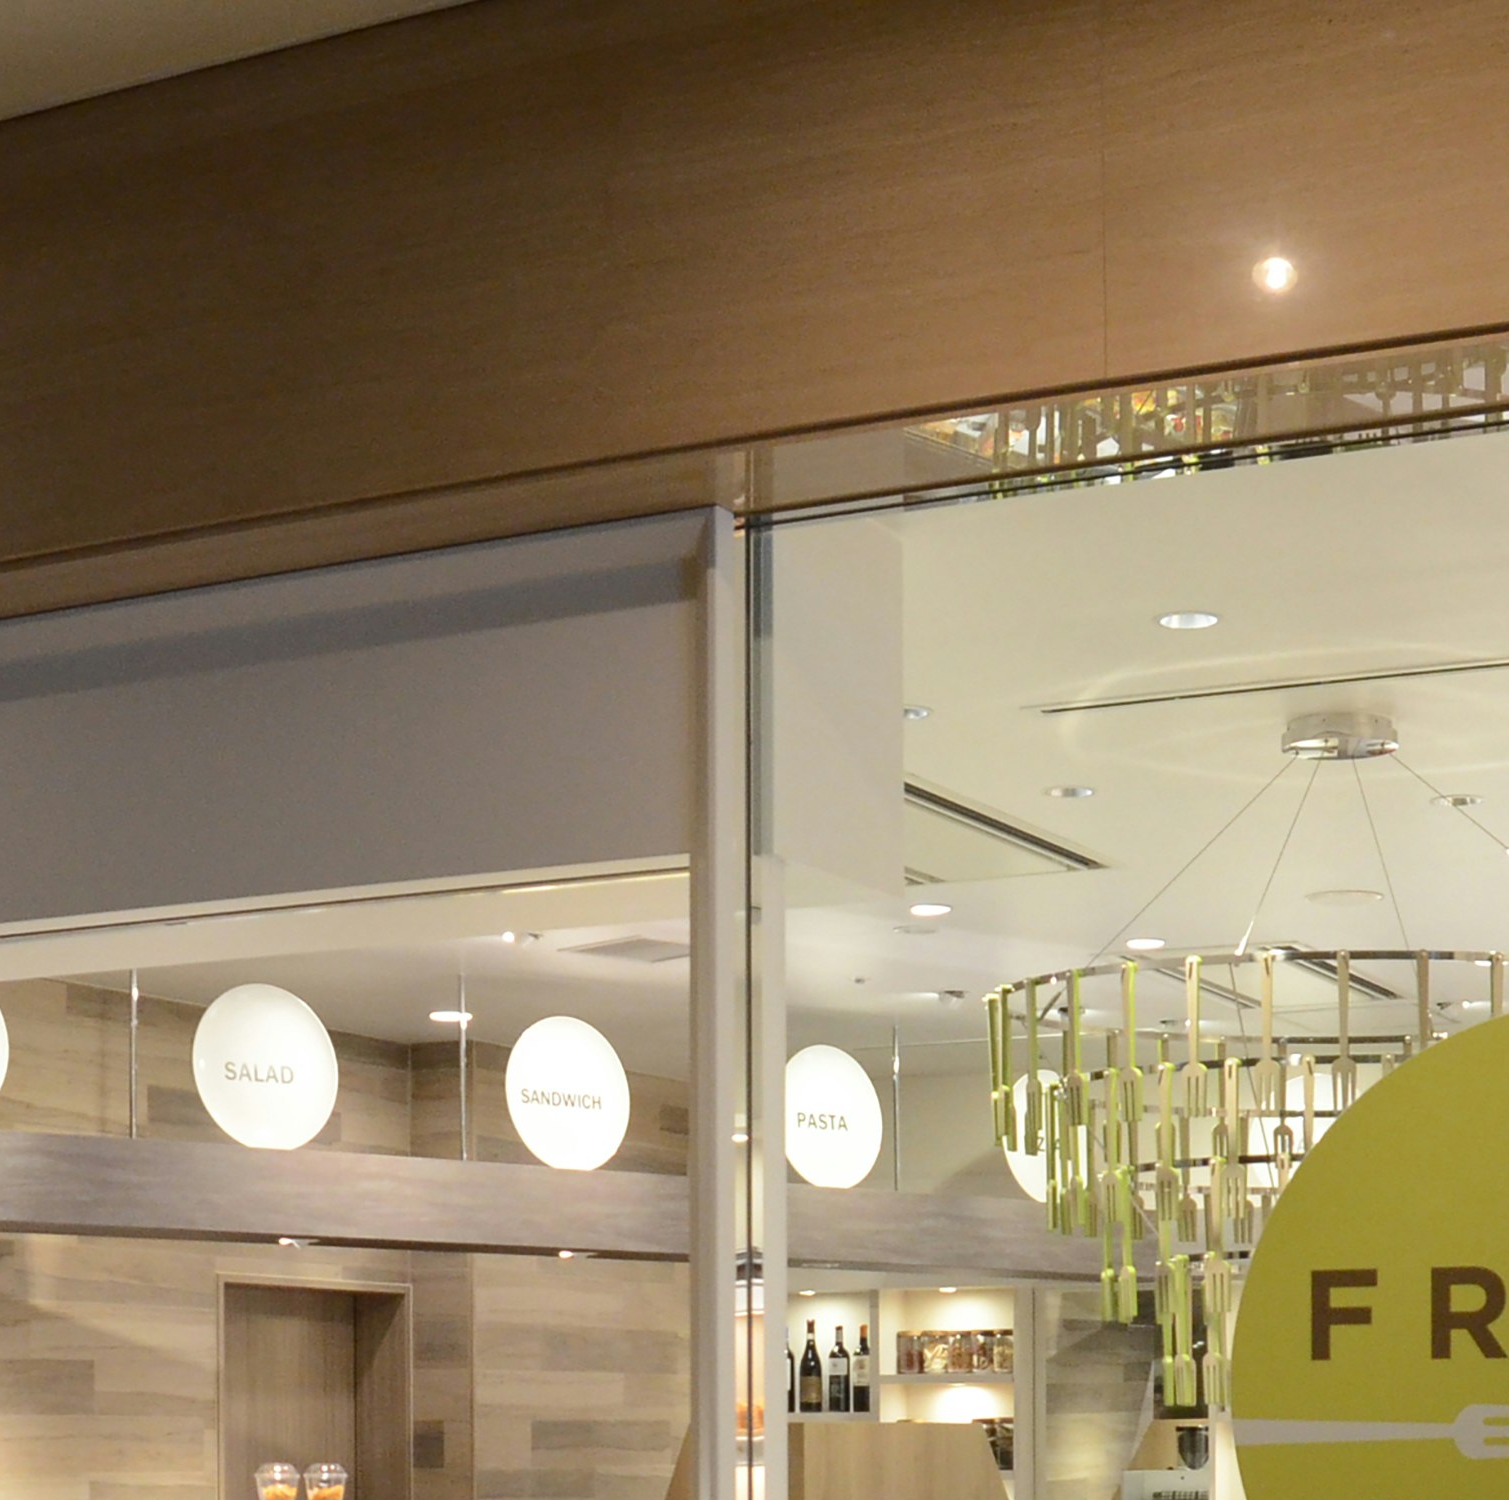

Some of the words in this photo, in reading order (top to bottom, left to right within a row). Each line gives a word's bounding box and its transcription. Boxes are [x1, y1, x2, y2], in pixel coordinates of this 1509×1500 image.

[224, 1061, 294, 1084] SALAD
[521, 1088, 602, 1110] SANDWICH
[797, 1112, 849, 1132] PASTA
